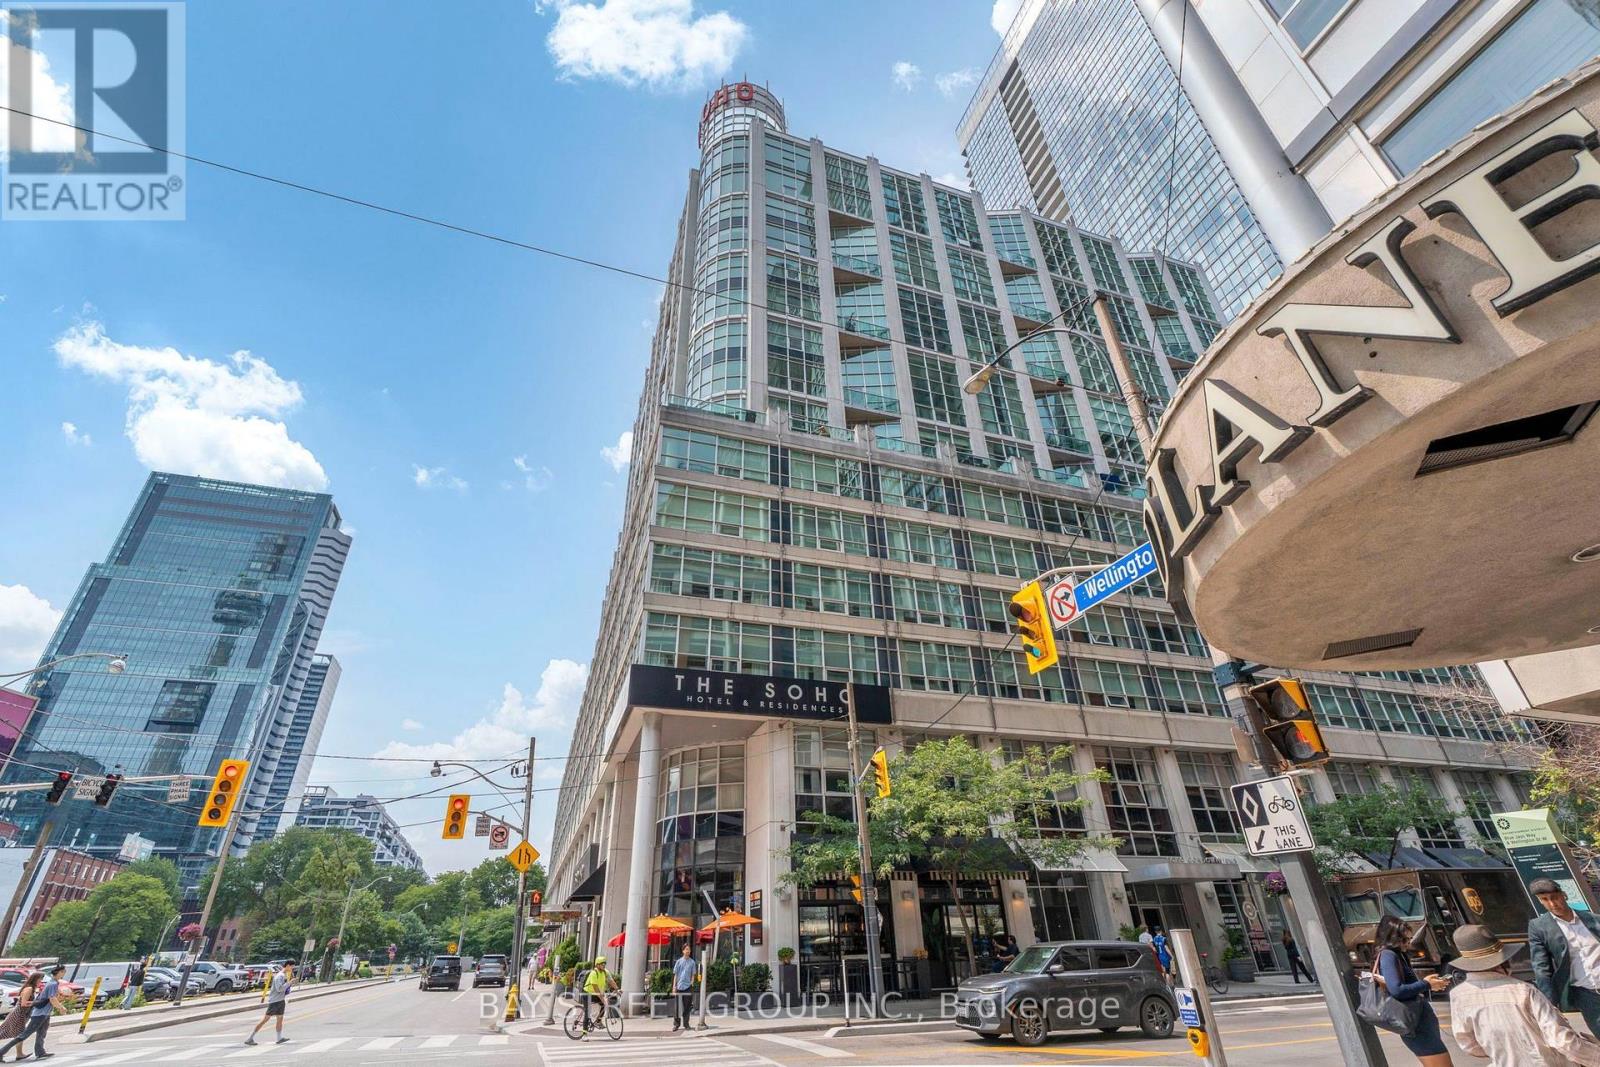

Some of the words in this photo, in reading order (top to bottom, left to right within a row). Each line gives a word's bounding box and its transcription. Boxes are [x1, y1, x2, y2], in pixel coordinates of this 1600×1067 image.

[1084, 550, 1153, 600] Wellingto
[674, 674, 734, 695] THE
[686, 695, 732, 706] HOTEL
[743, 699, 750, 707] &
[760, 700, 844, 714] RESIDENCES
[1274, 824, 1297, 837] THIS
[1275, 836, 1303, 849] LANE
